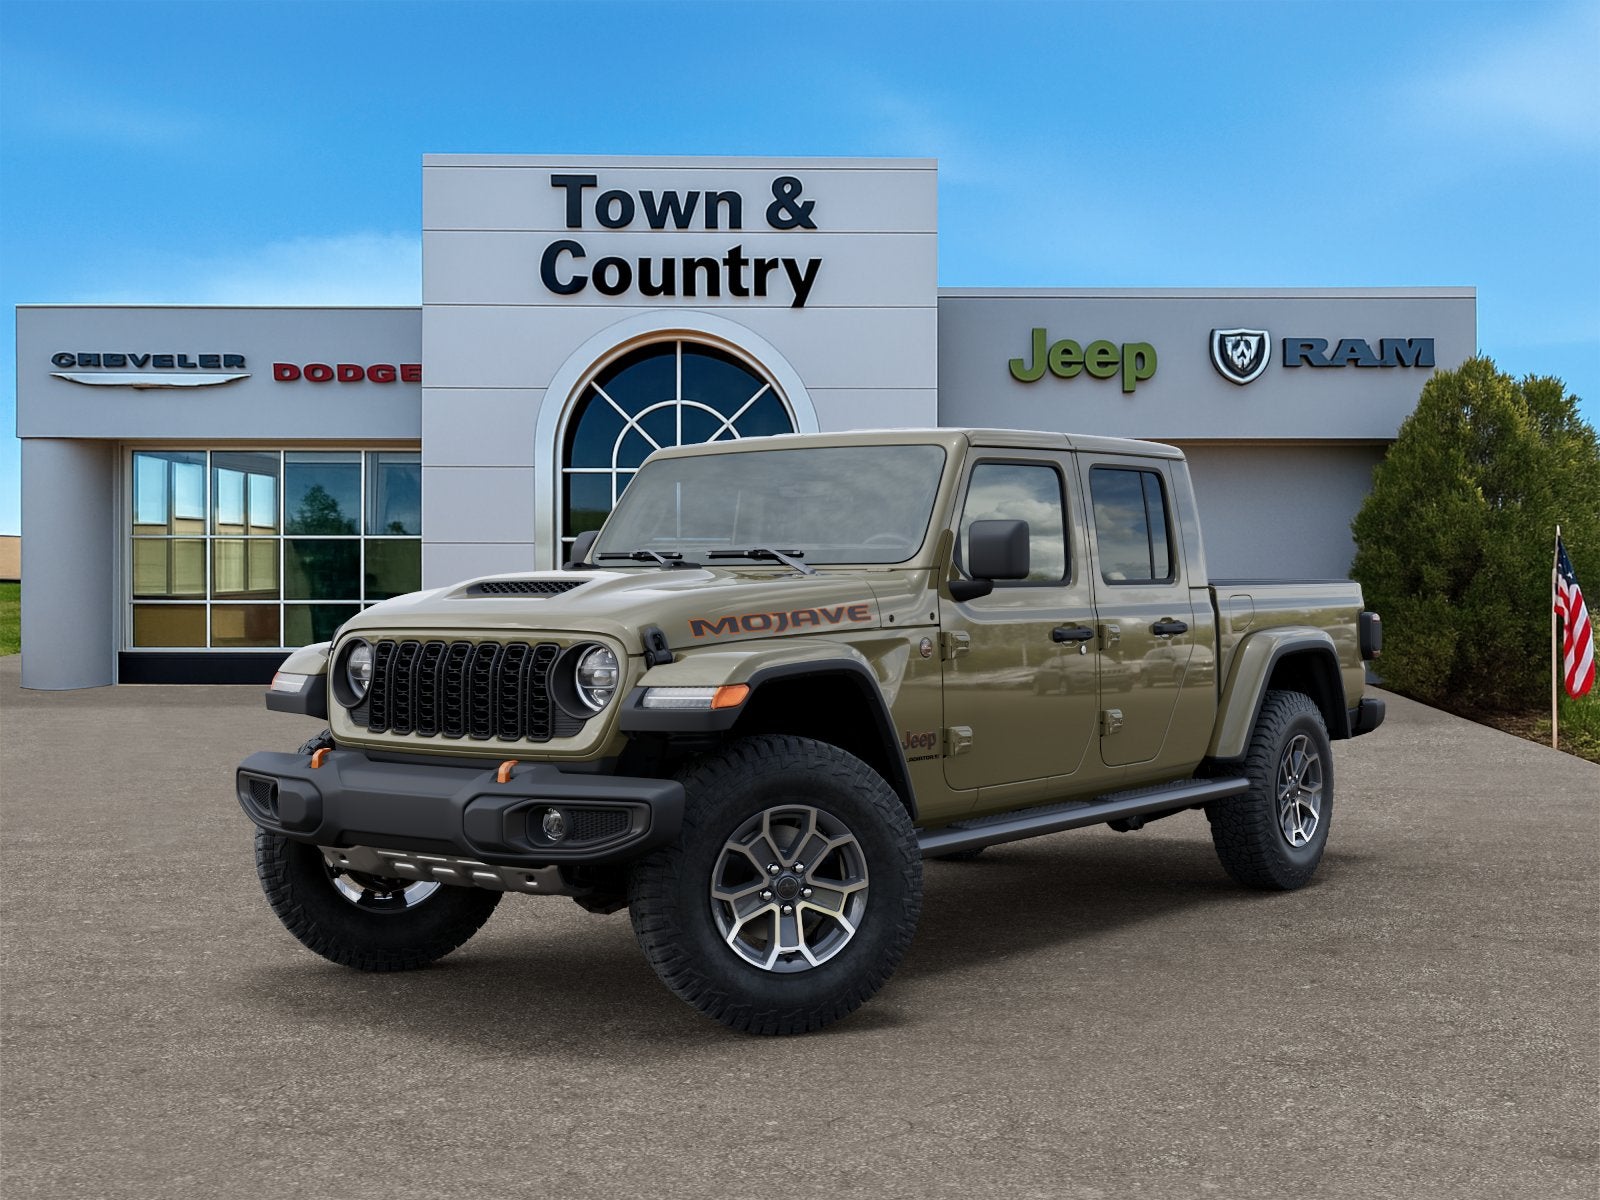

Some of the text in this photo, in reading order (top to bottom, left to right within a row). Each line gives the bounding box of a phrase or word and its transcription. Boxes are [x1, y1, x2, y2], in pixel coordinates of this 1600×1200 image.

[550, 174, 818, 230] Town &
[540, 239, 822, 308] Country
[1009, 328, 1158, 392] Jeep
[1283, 337, 1435, 367] RAM
[272, 363, 421, 382] DODGE
[688, 604, 871, 637] MOJAVE
[902, 730, 936, 750] Jeep
